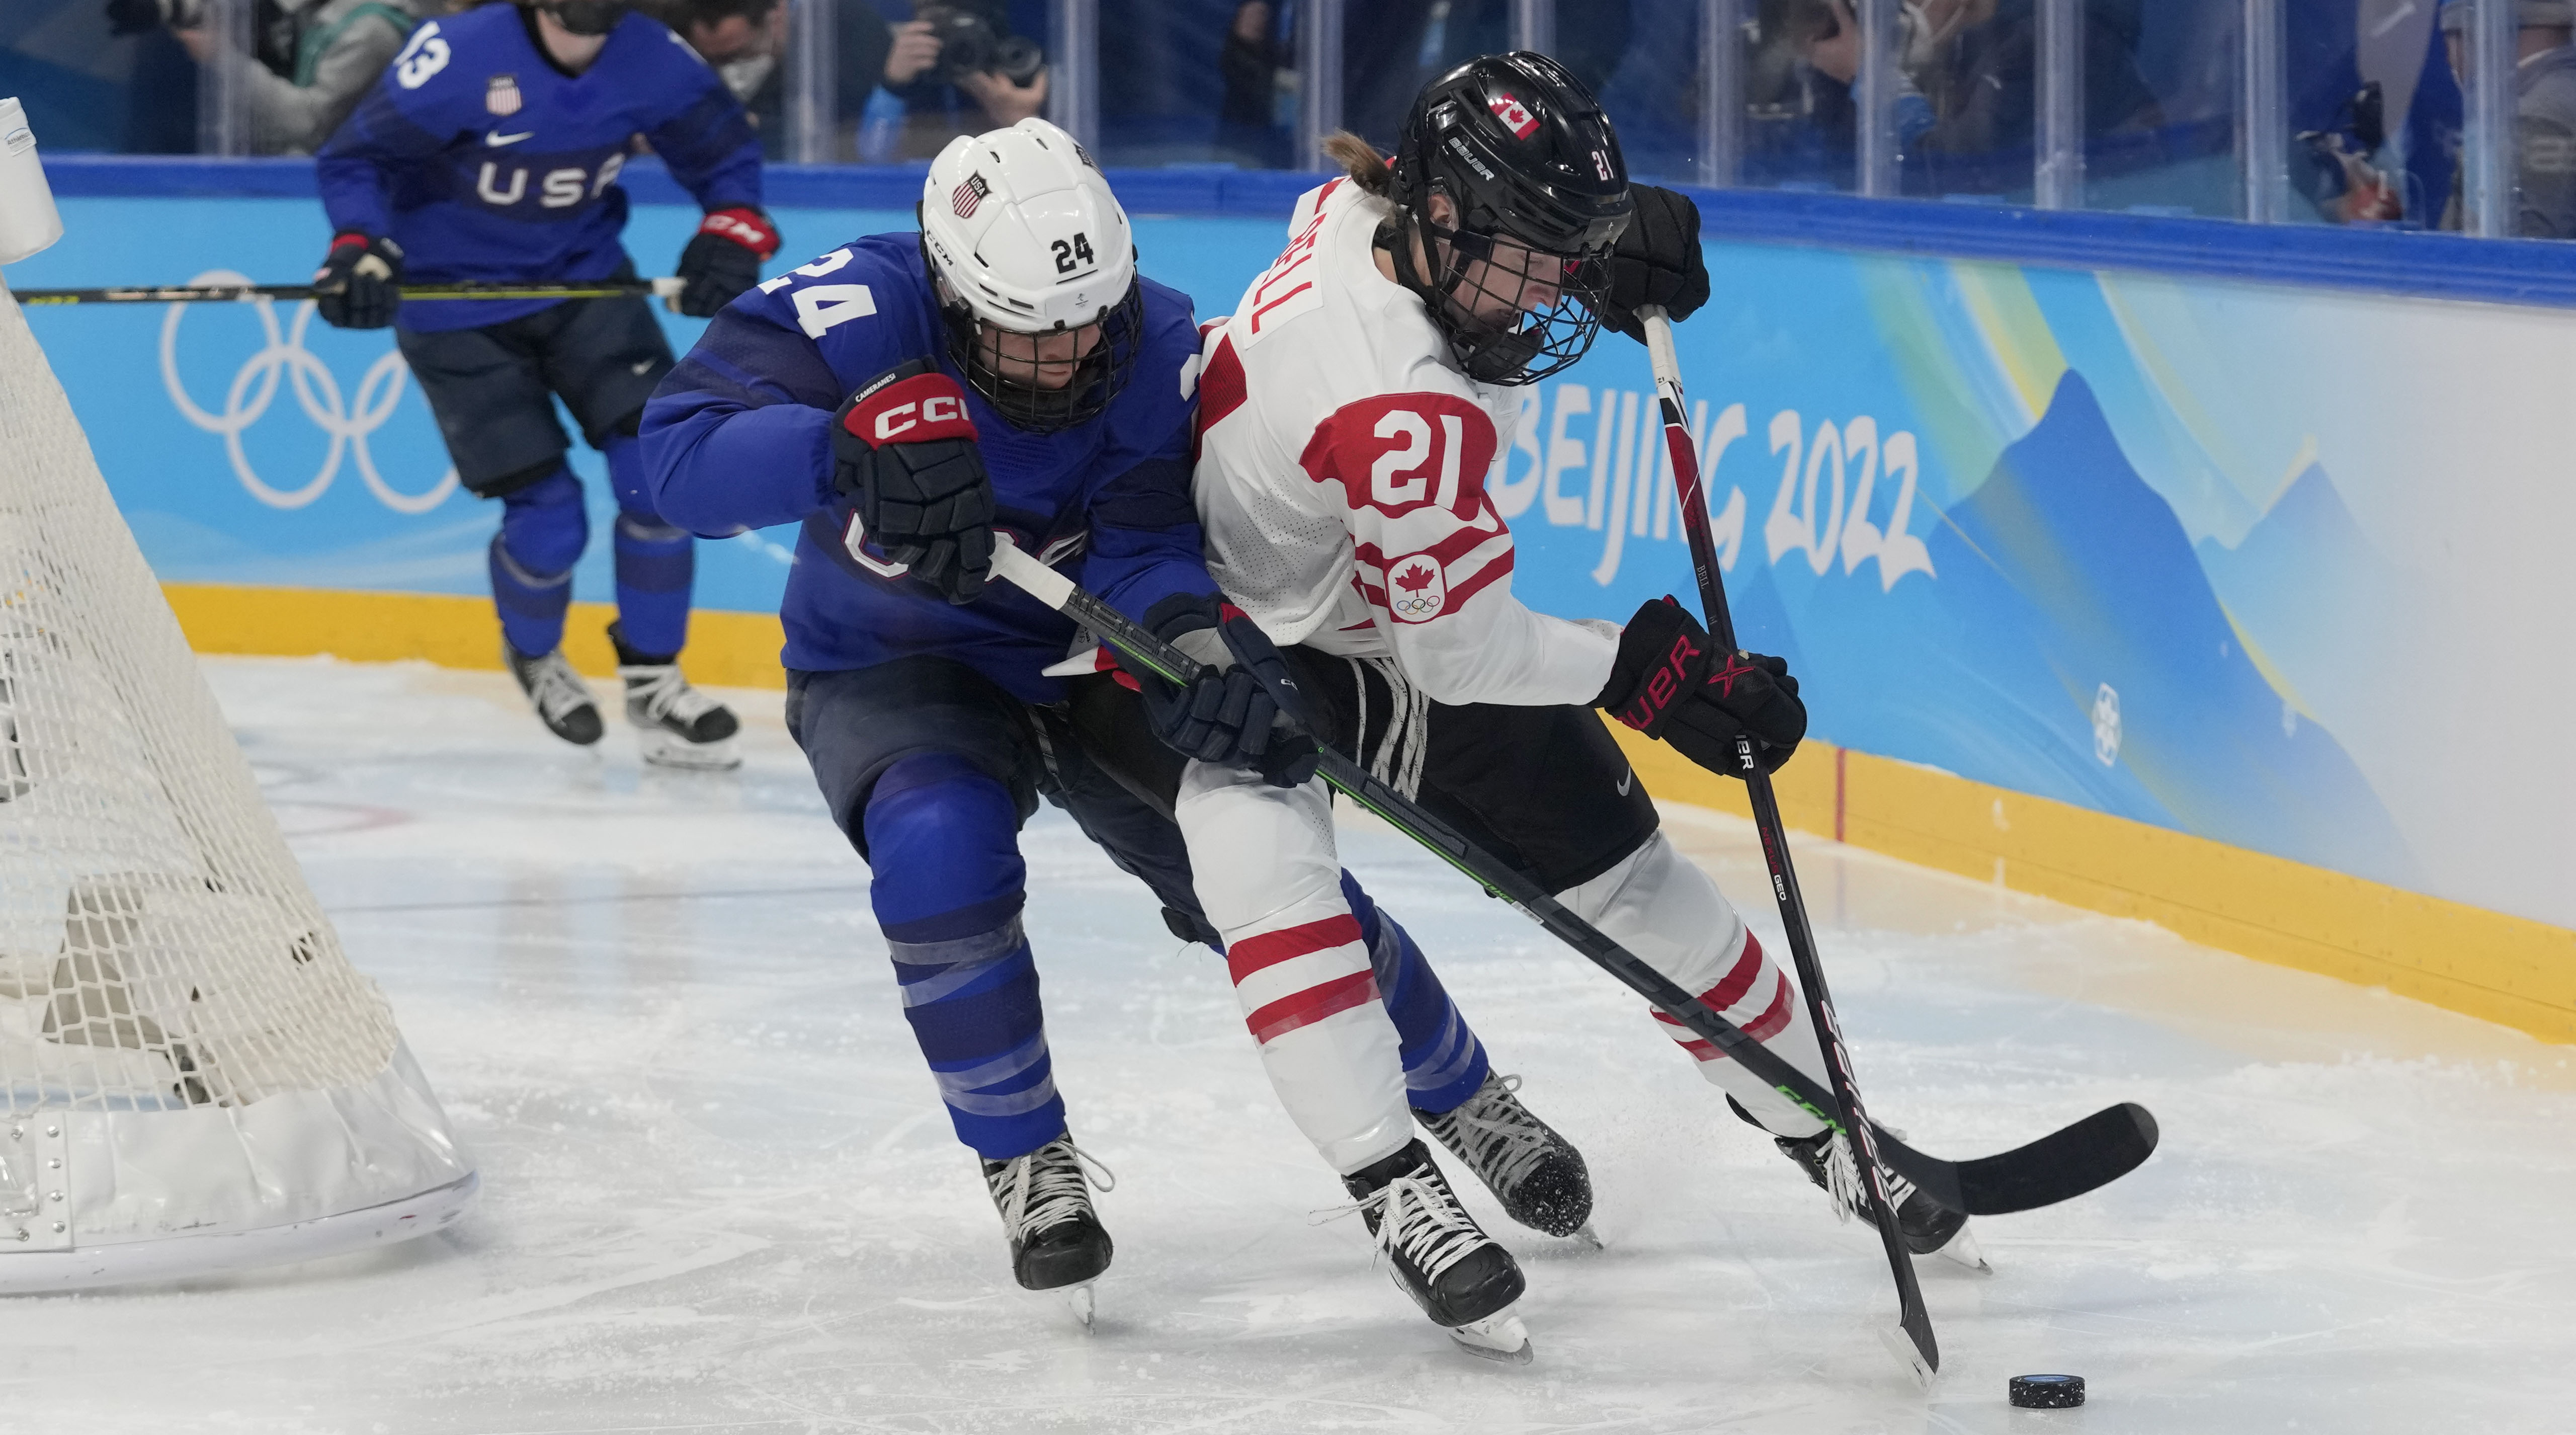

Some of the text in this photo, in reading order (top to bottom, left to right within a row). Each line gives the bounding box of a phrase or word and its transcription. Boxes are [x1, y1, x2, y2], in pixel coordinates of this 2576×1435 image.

[393, 21, 451, 89] 13
[1448, 136, 1495, 181] BAUER
[1592, 149, 1614, 181] 21
[970, 176, 986, 196] USA
[926, 229, 954, 266] CCM
[1051, 232, 1094, 273] 24
[757, 248, 877, 340] 24
[855, 372, 896, 403] CAMERANESI
[1371, 409, 1464, 511] 21
[1487, 383, 1937, 594] BEIJING 2022
[1696, 564, 1710, 590] BELL
